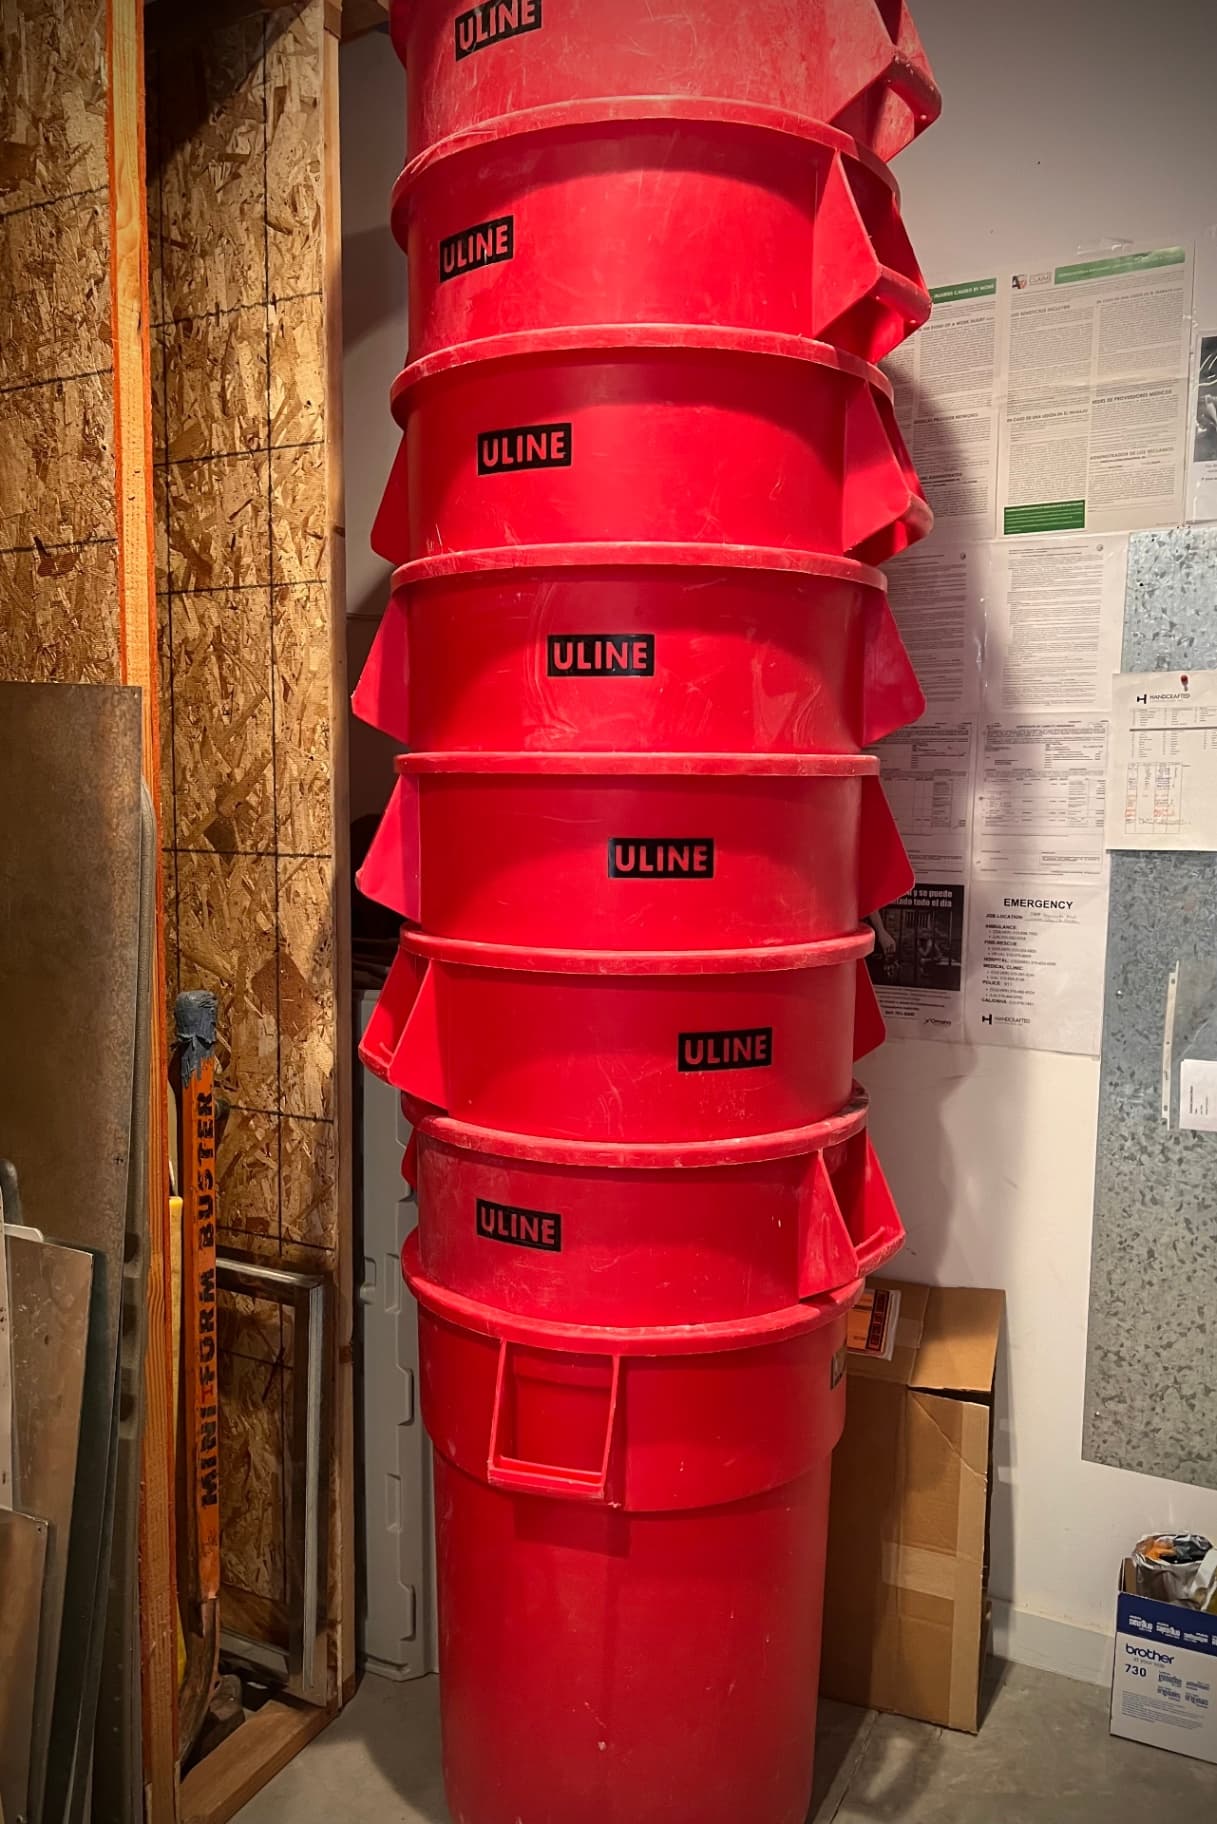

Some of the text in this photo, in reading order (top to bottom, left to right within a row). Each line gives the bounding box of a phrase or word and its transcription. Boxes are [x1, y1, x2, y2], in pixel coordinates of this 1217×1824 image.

[459, 0, 536, 50] ULINE
[443, 224, 508, 273] ULINE
[482, 431, 565, 467] ULINE
[553, 641, 648, 670] ULINE
[614, 845, 708, 872] ULINE
[1003, 898, 1074, 910] EMERGENCY
[684, 1034, 767, 1065] ULINE
[480, 1205, 555, 1245] ULINE
[198, 1092, 218, 1509] MINI FORM BUSTER
[1125, 1642, 1175, 1665] brother
[1125, 1663, 1147, 1678] 730
